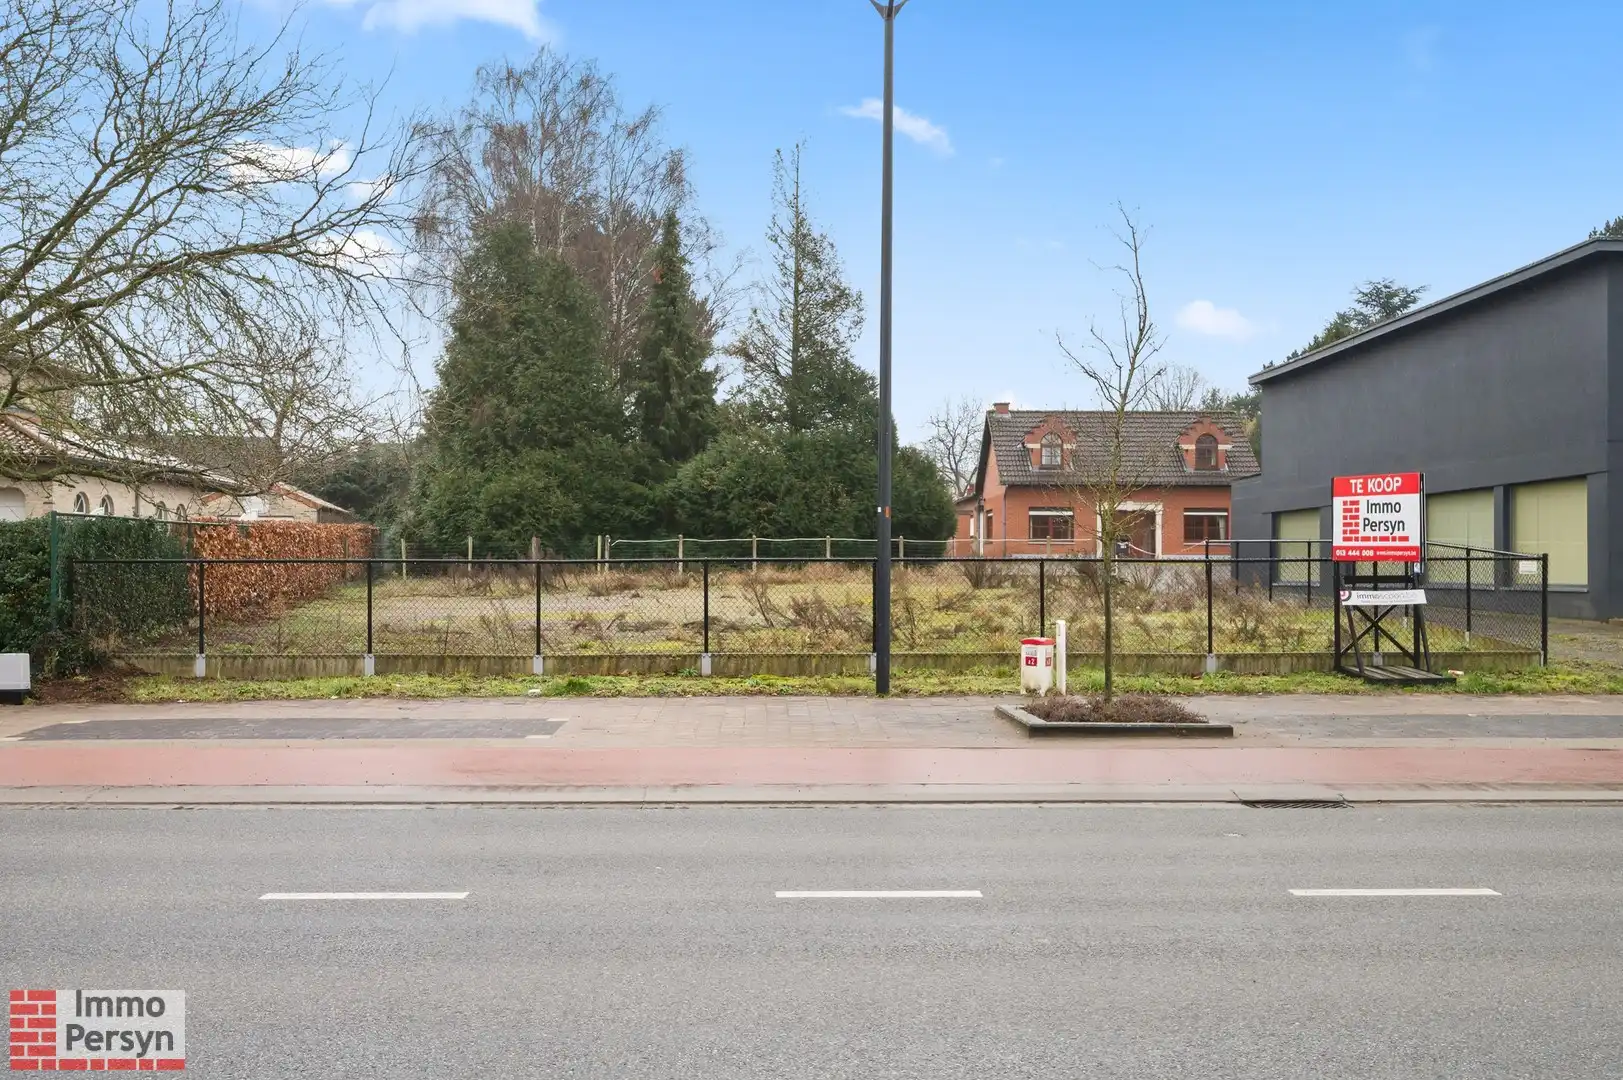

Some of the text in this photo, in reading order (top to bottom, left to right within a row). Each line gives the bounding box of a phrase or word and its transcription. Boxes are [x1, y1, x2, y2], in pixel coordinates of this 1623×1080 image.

[1350, 476, 1402, 493] TE KOOP
[1366, 499, 1402, 514] Immo
[1363, 517, 1405, 535] Persyn
[1347, 549, 1360, 557] 444
